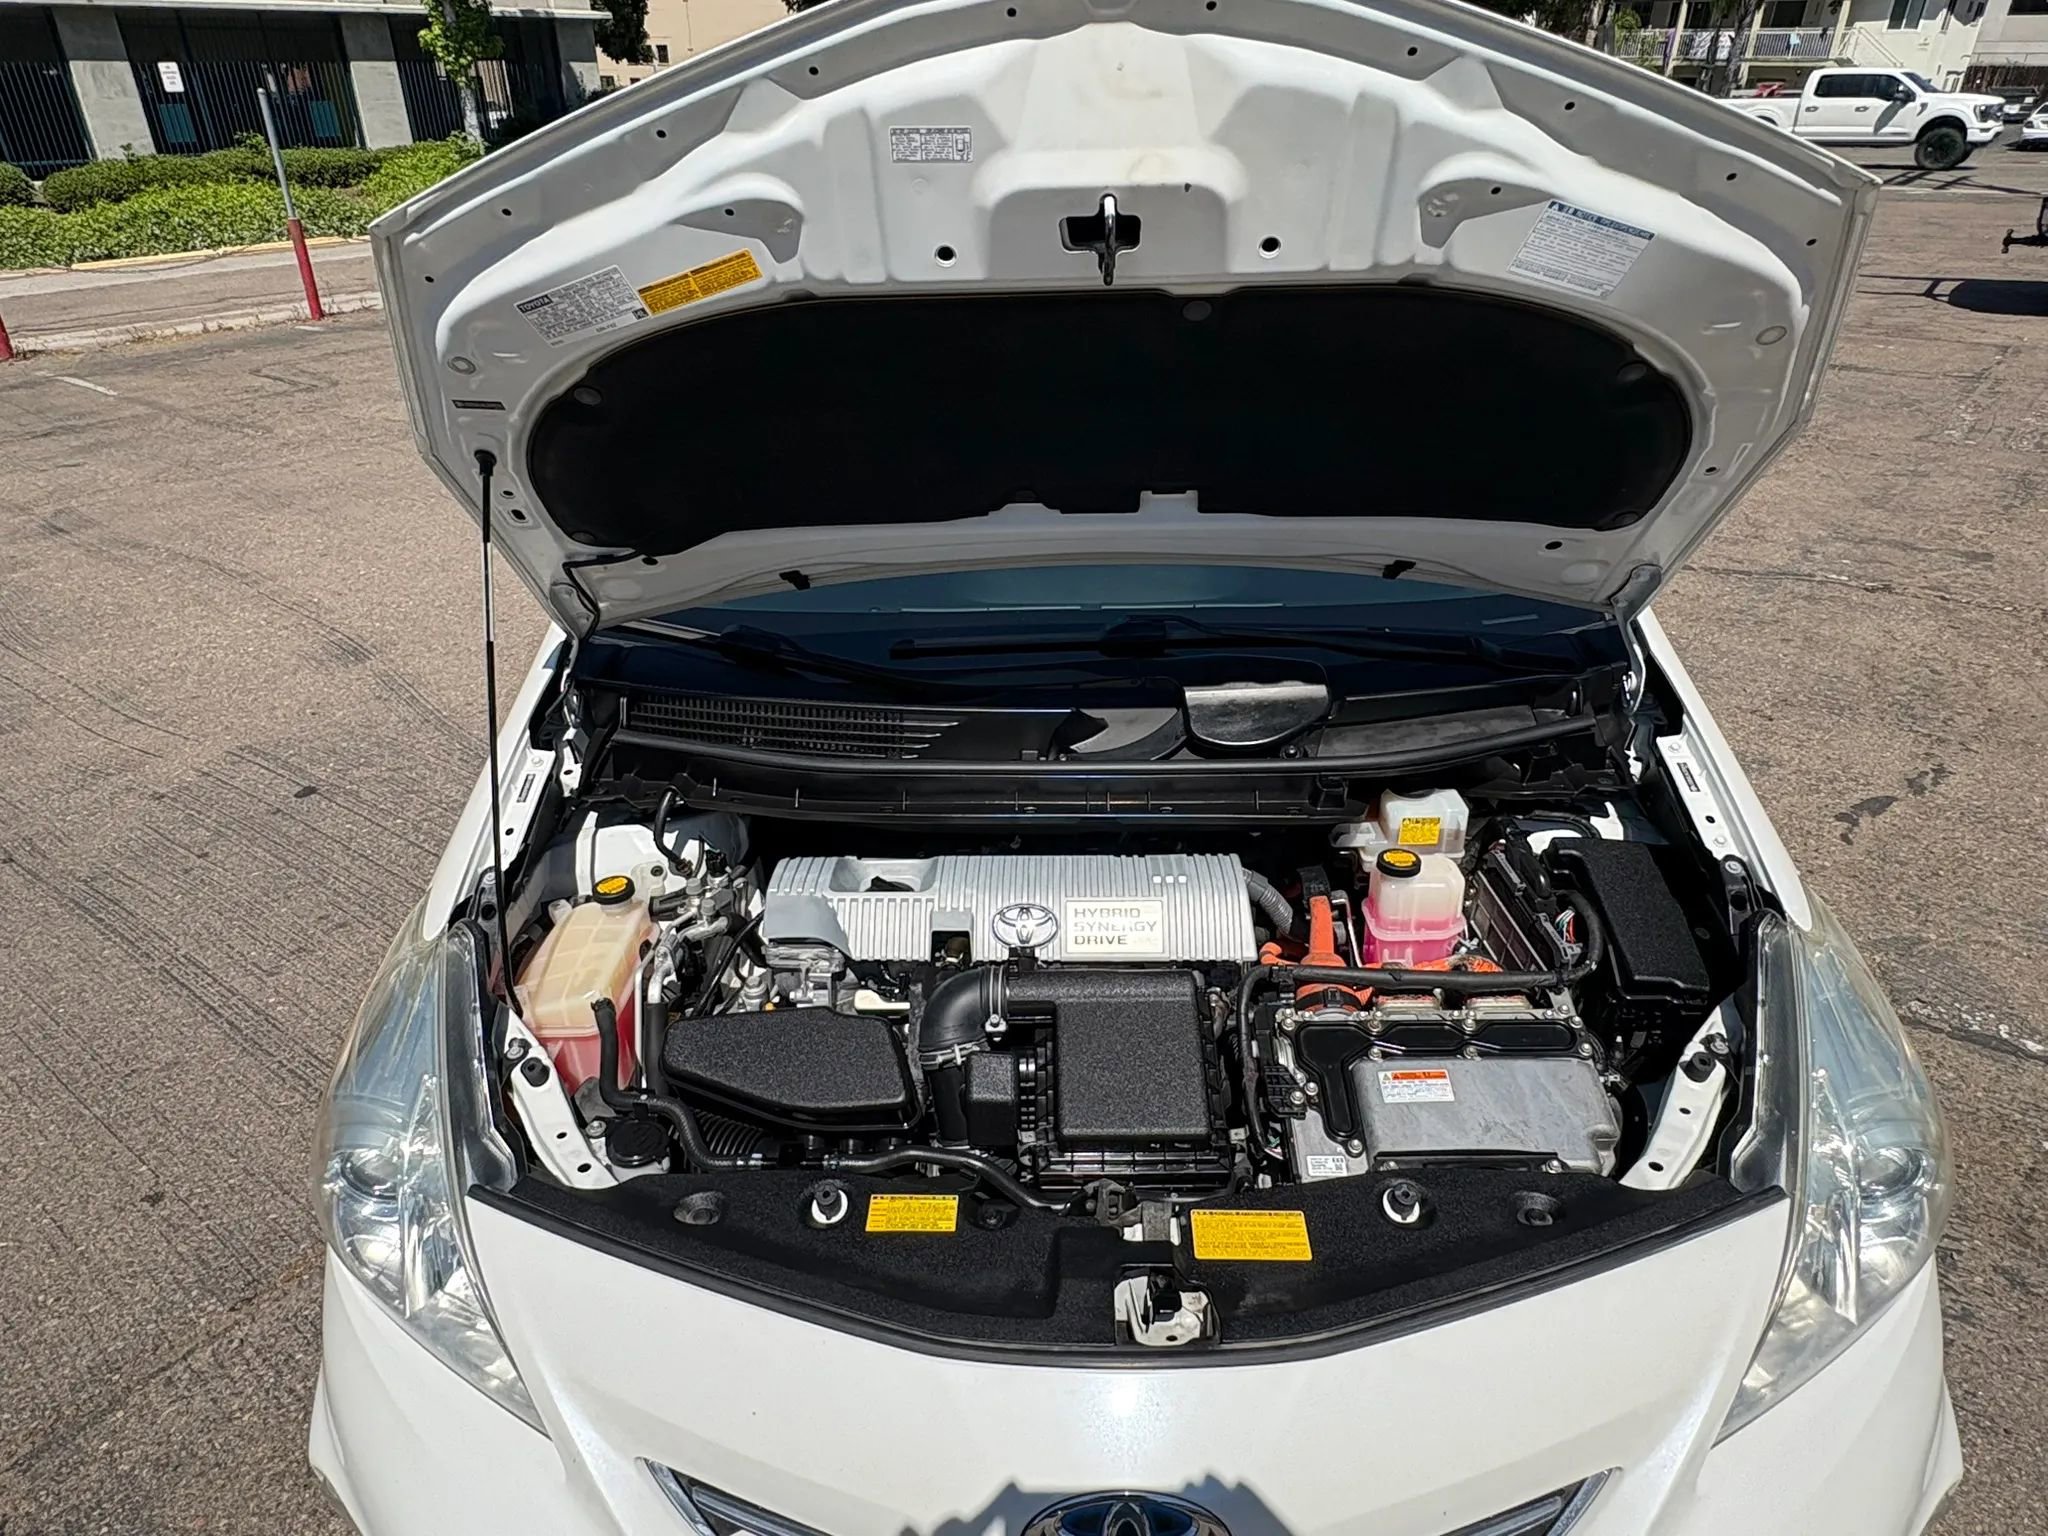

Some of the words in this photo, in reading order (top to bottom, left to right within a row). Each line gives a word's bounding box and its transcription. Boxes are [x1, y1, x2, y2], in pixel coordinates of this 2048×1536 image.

[519, 297, 550, 312] TOYOTA
[1074, 908, 1141, 918] HYBRID
[1074, 935, 1128, 945] DRIVE
